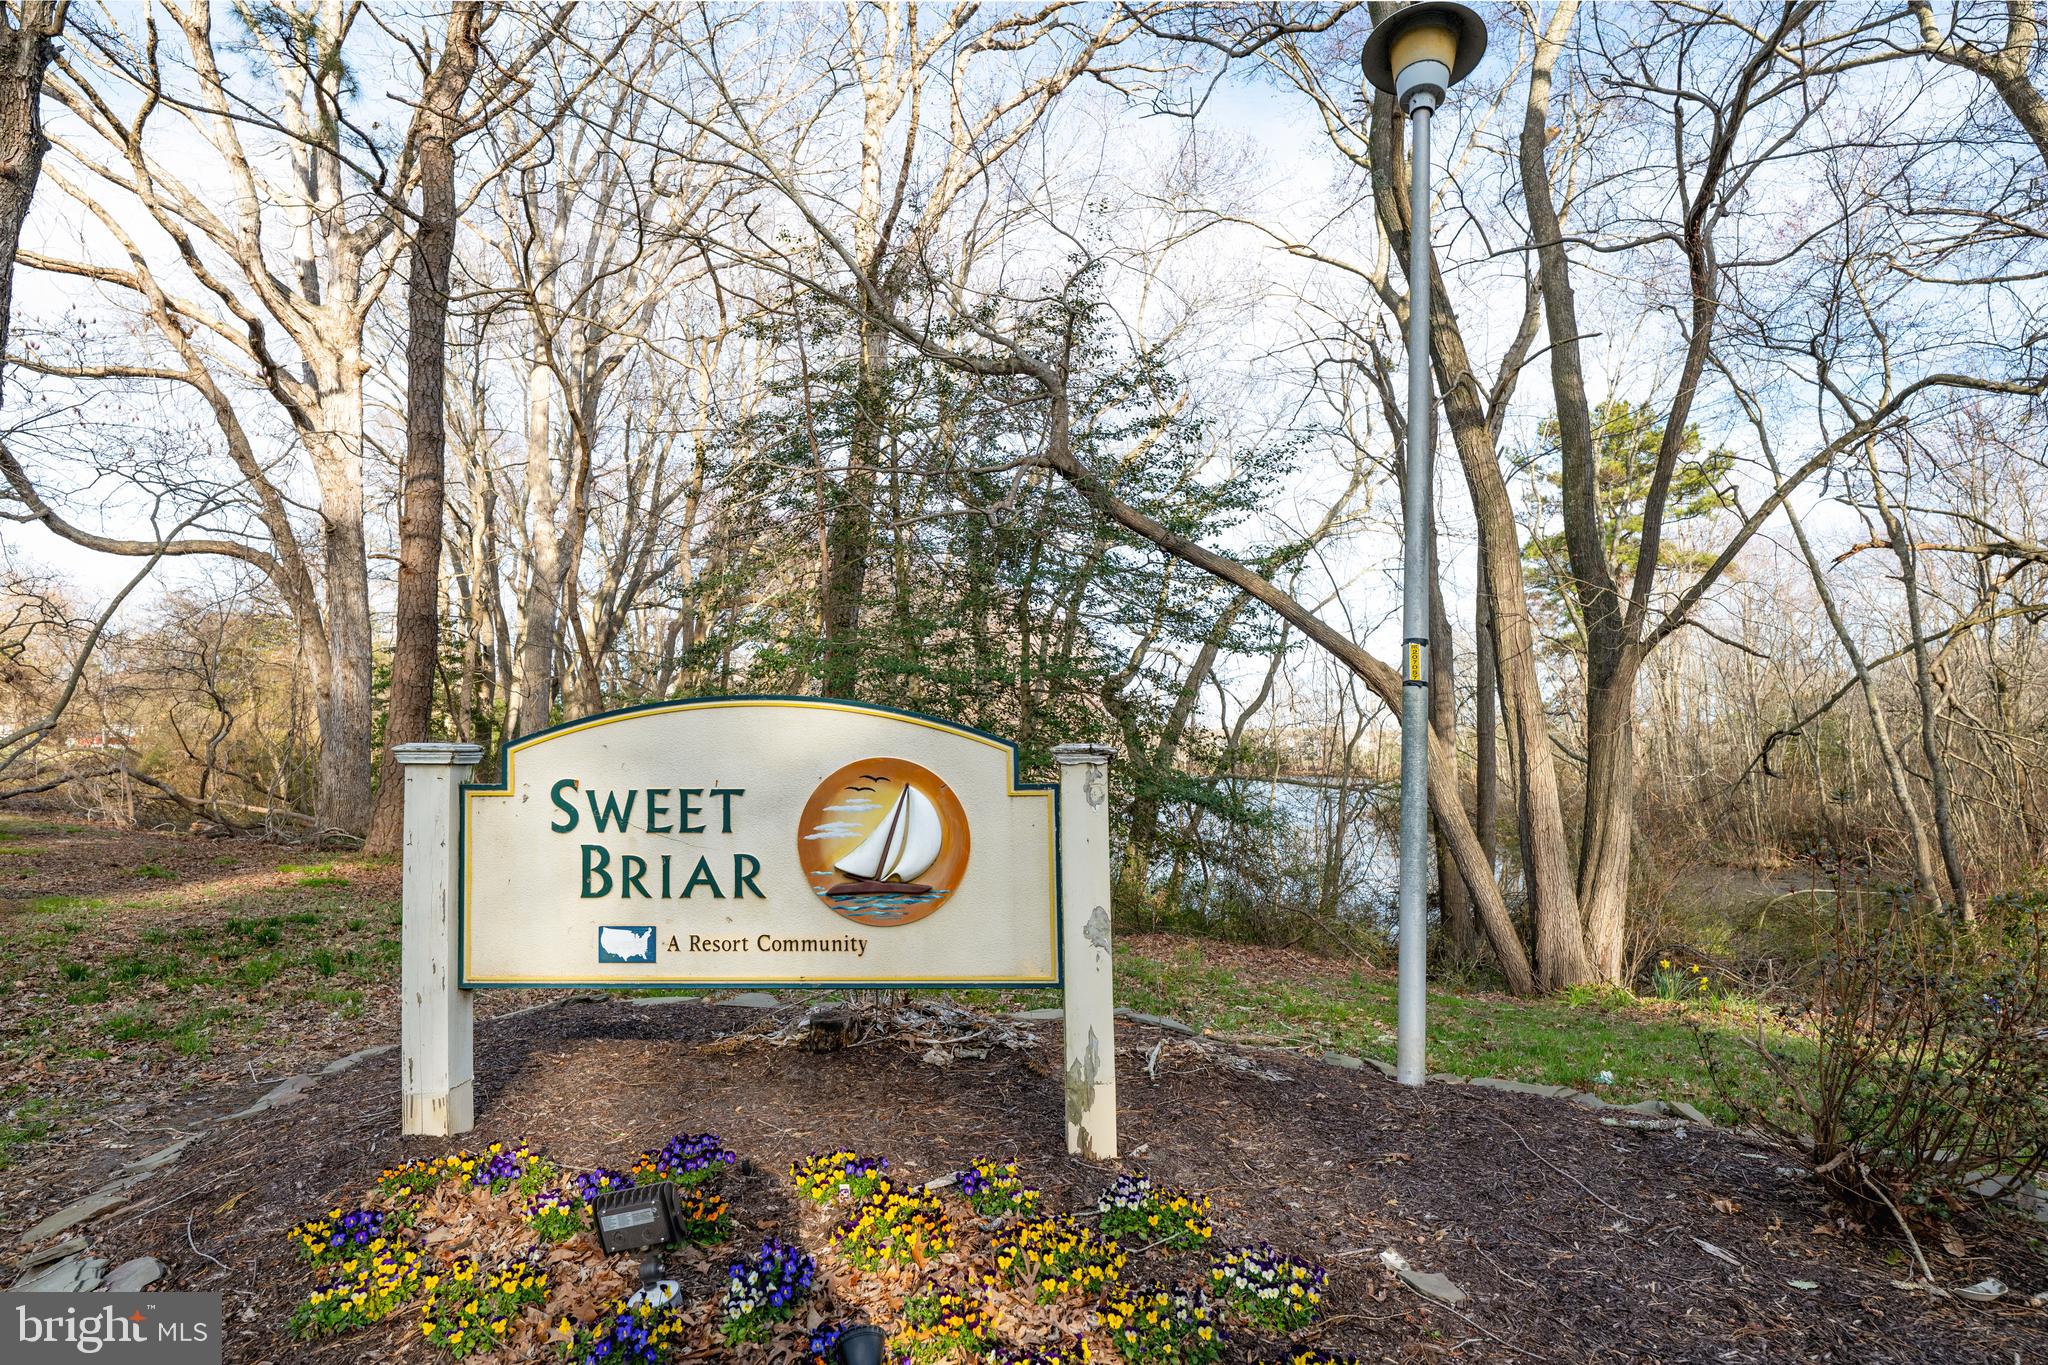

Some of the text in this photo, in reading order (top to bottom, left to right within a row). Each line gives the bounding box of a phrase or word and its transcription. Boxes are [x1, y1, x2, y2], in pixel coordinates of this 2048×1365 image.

[550, 778, 746, 834] SWEET
[580, 844, 767, 899] BRIAR
[667, 934, 868, 957] A Resort Community
